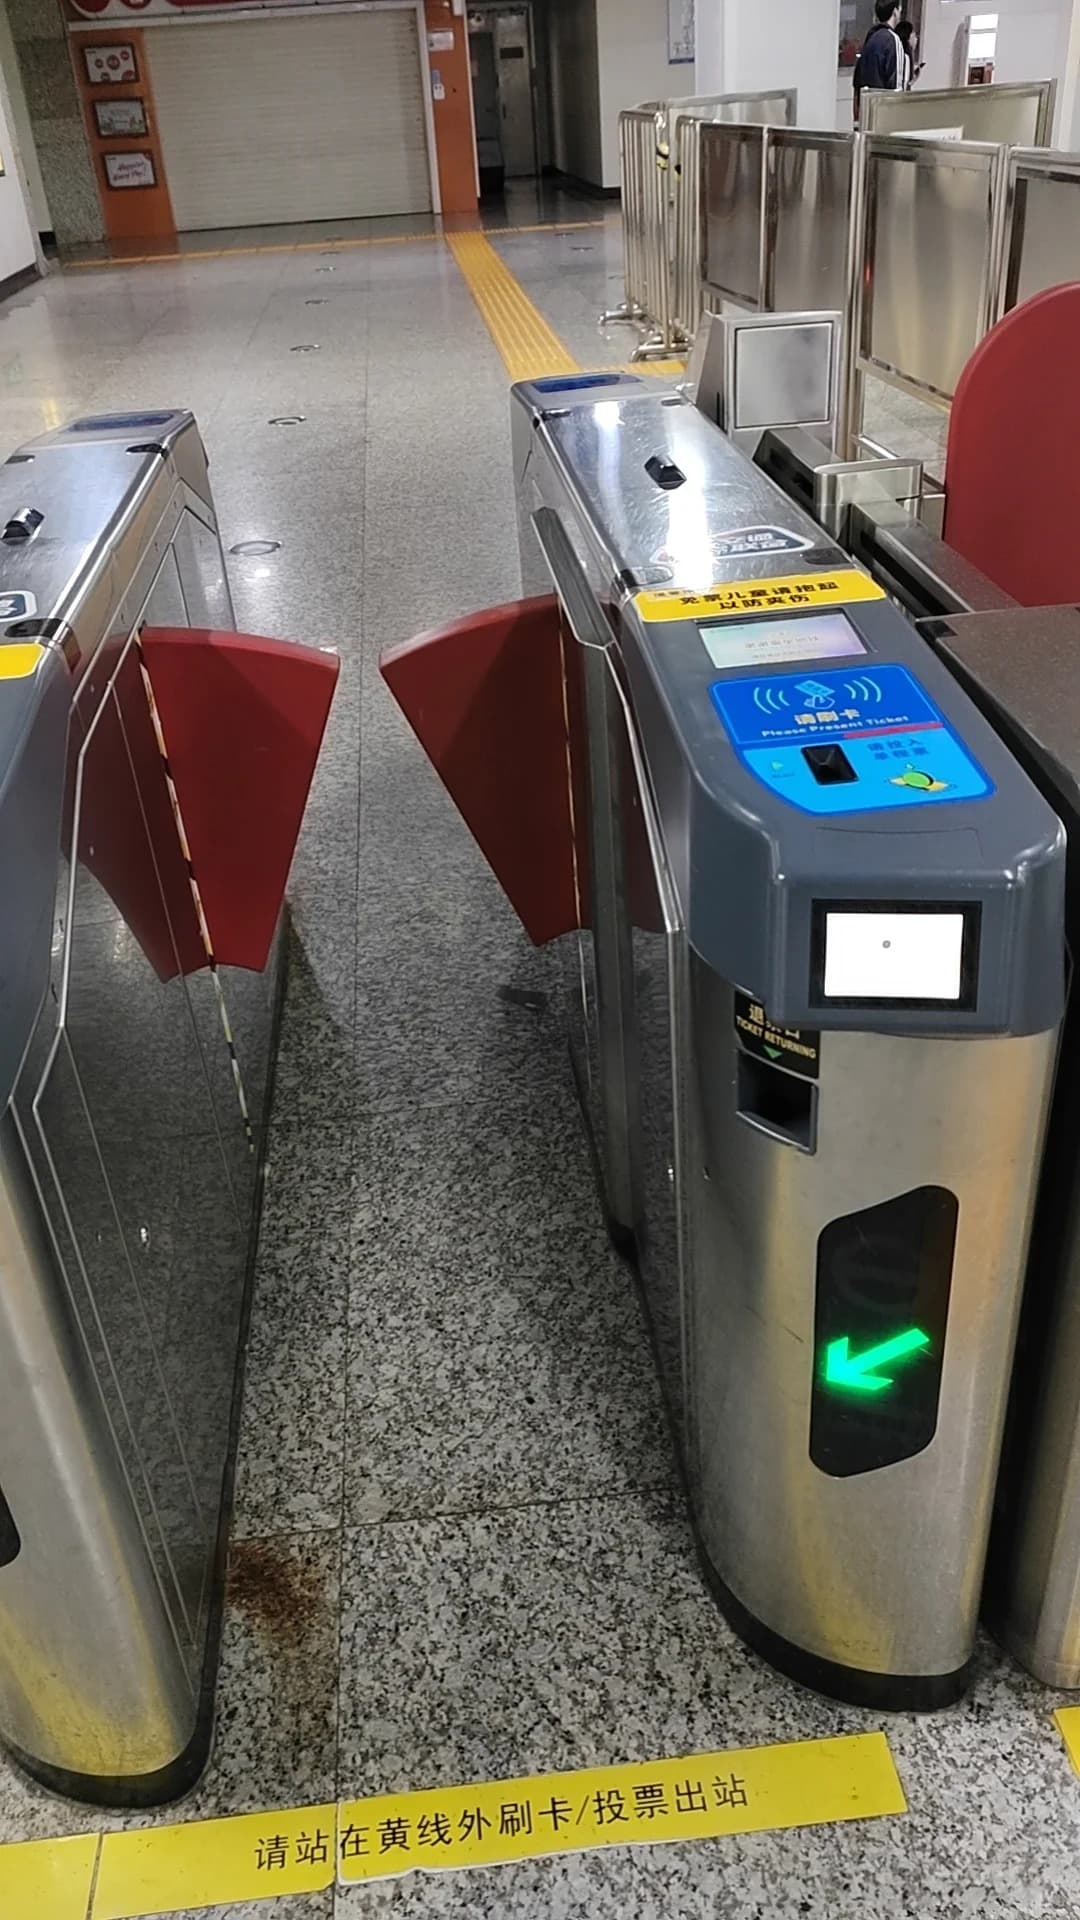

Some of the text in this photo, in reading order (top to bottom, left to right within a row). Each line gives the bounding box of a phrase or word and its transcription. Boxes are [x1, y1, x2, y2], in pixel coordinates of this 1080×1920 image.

[720, 593, 810, 610] 以防夹伤
[761, 715, 909, 737] Please Present Ticket
[794, 708, 861, 725] 请刷卡
[736, 1014, 817, 1059] TICKET RETURNING
[254, 1773, 749, 1872] 请站在黄线外刷卡/投票出站
